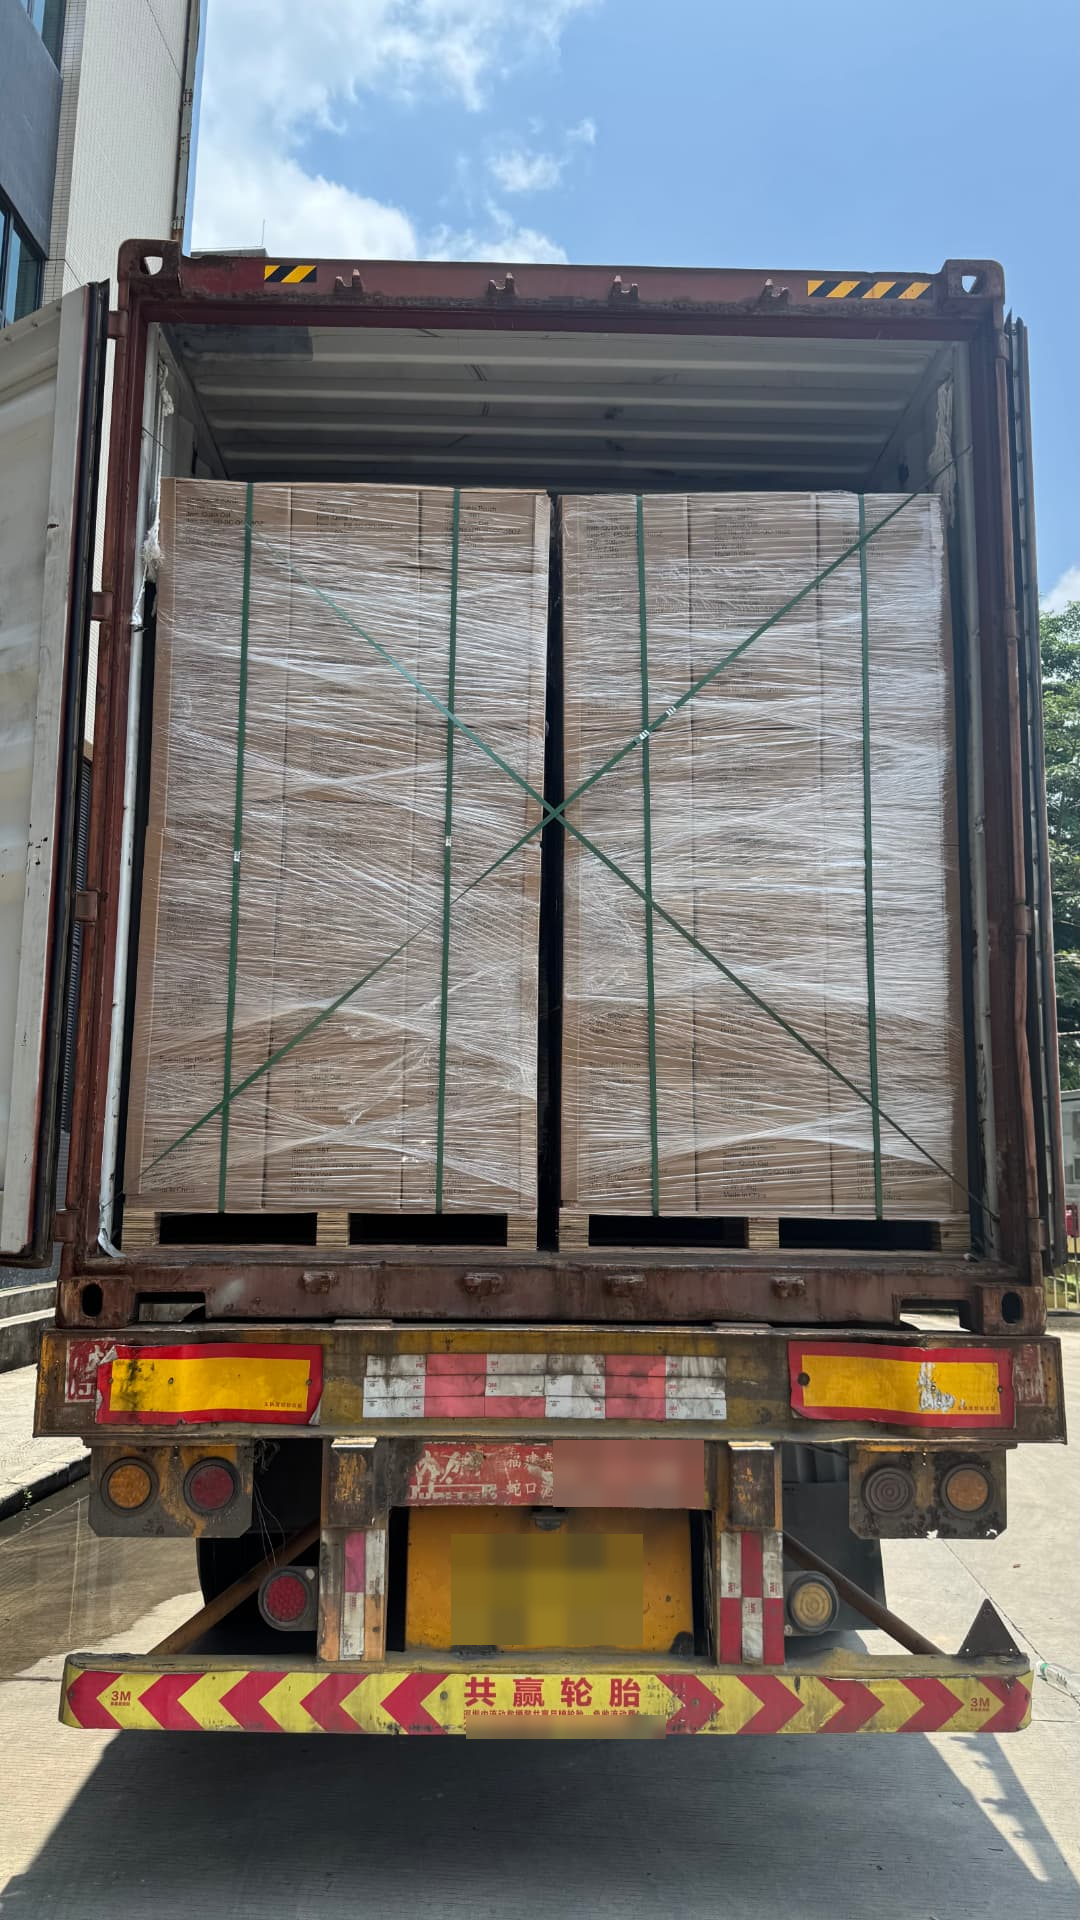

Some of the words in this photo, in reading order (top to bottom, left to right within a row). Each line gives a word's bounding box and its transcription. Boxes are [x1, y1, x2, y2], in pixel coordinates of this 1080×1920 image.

[111, 1690, 131, 1701] 3M
[464, 1676, 641, 1708] 共赢轮胎
[970, 1697, 990, 1708] 3M
